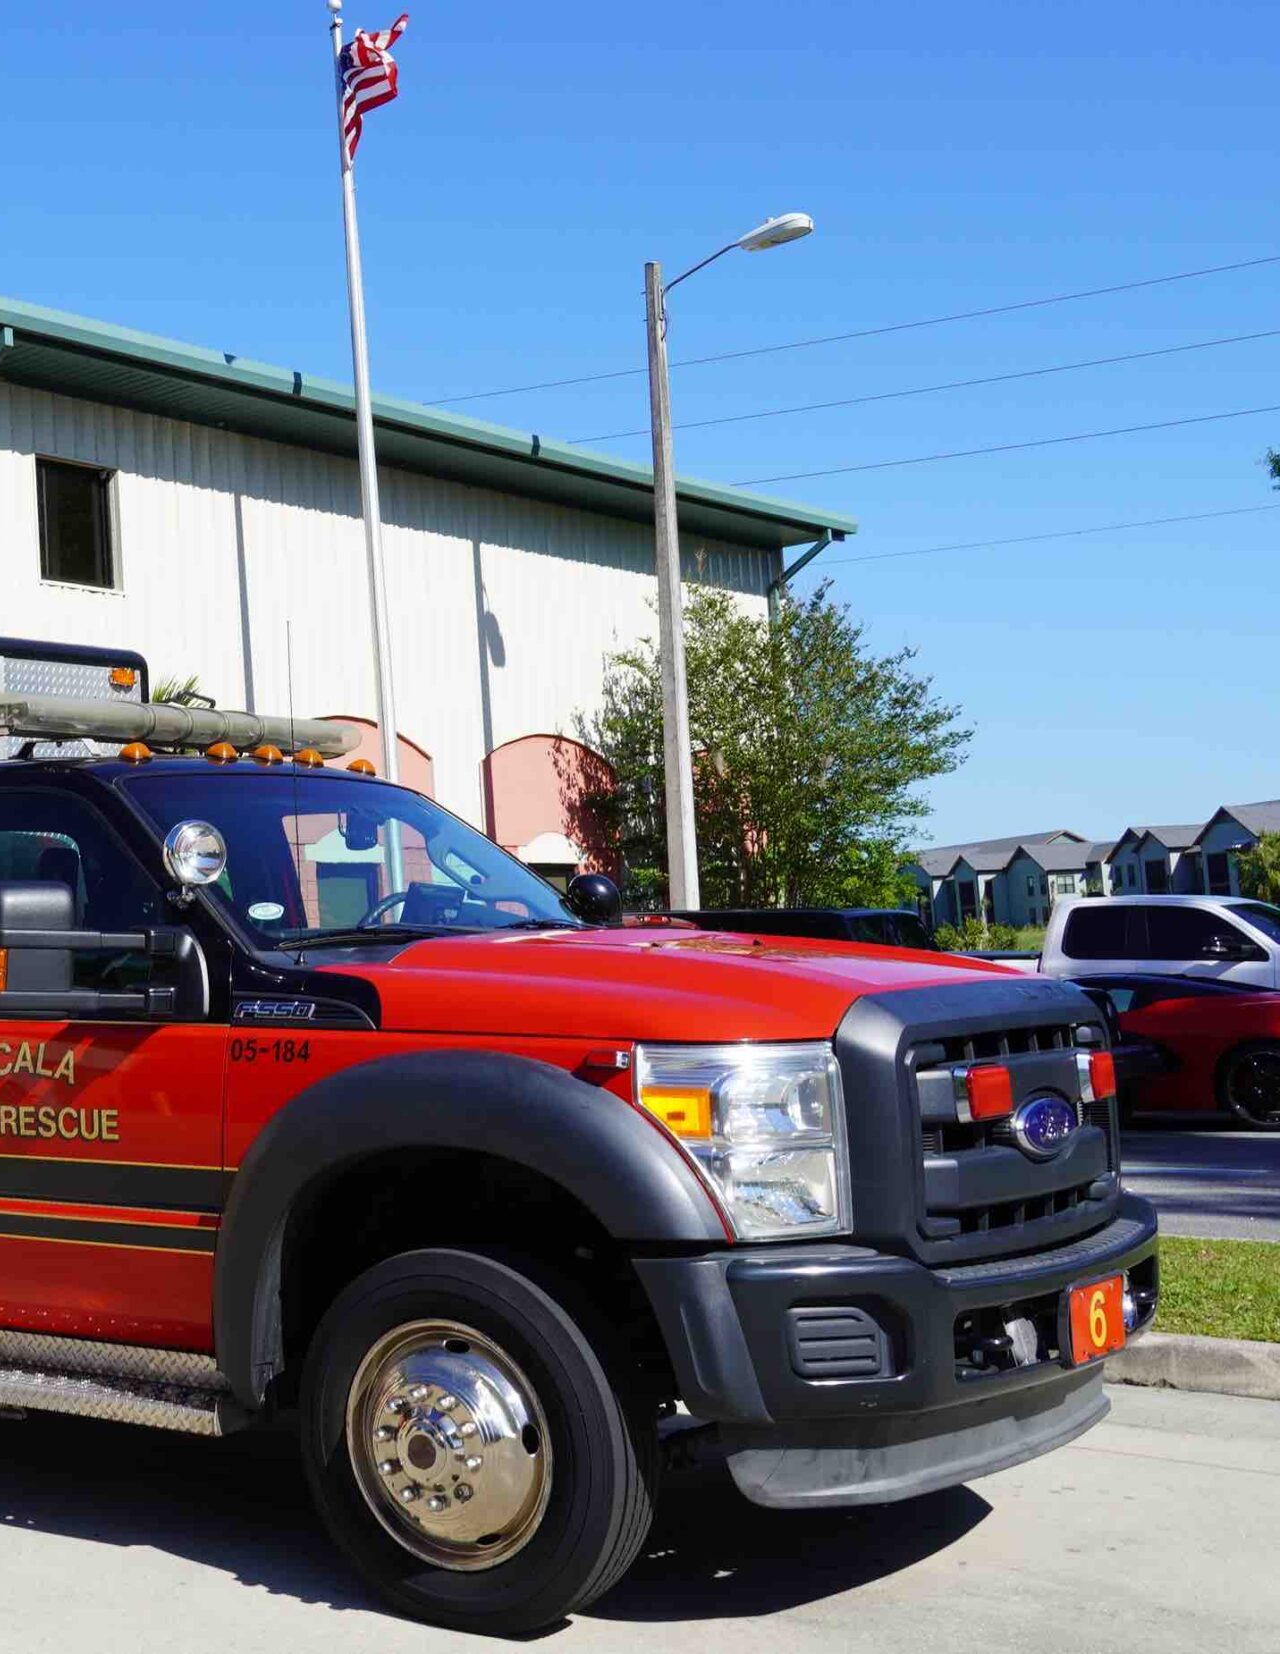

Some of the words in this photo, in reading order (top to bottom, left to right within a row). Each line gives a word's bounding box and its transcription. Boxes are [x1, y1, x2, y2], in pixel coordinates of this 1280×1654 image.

[230, 1038, 310, 1063] 05-184
[0, 1105, 120, 1140] RESCUE
[1089, 1290, 1107, 1348] 6
